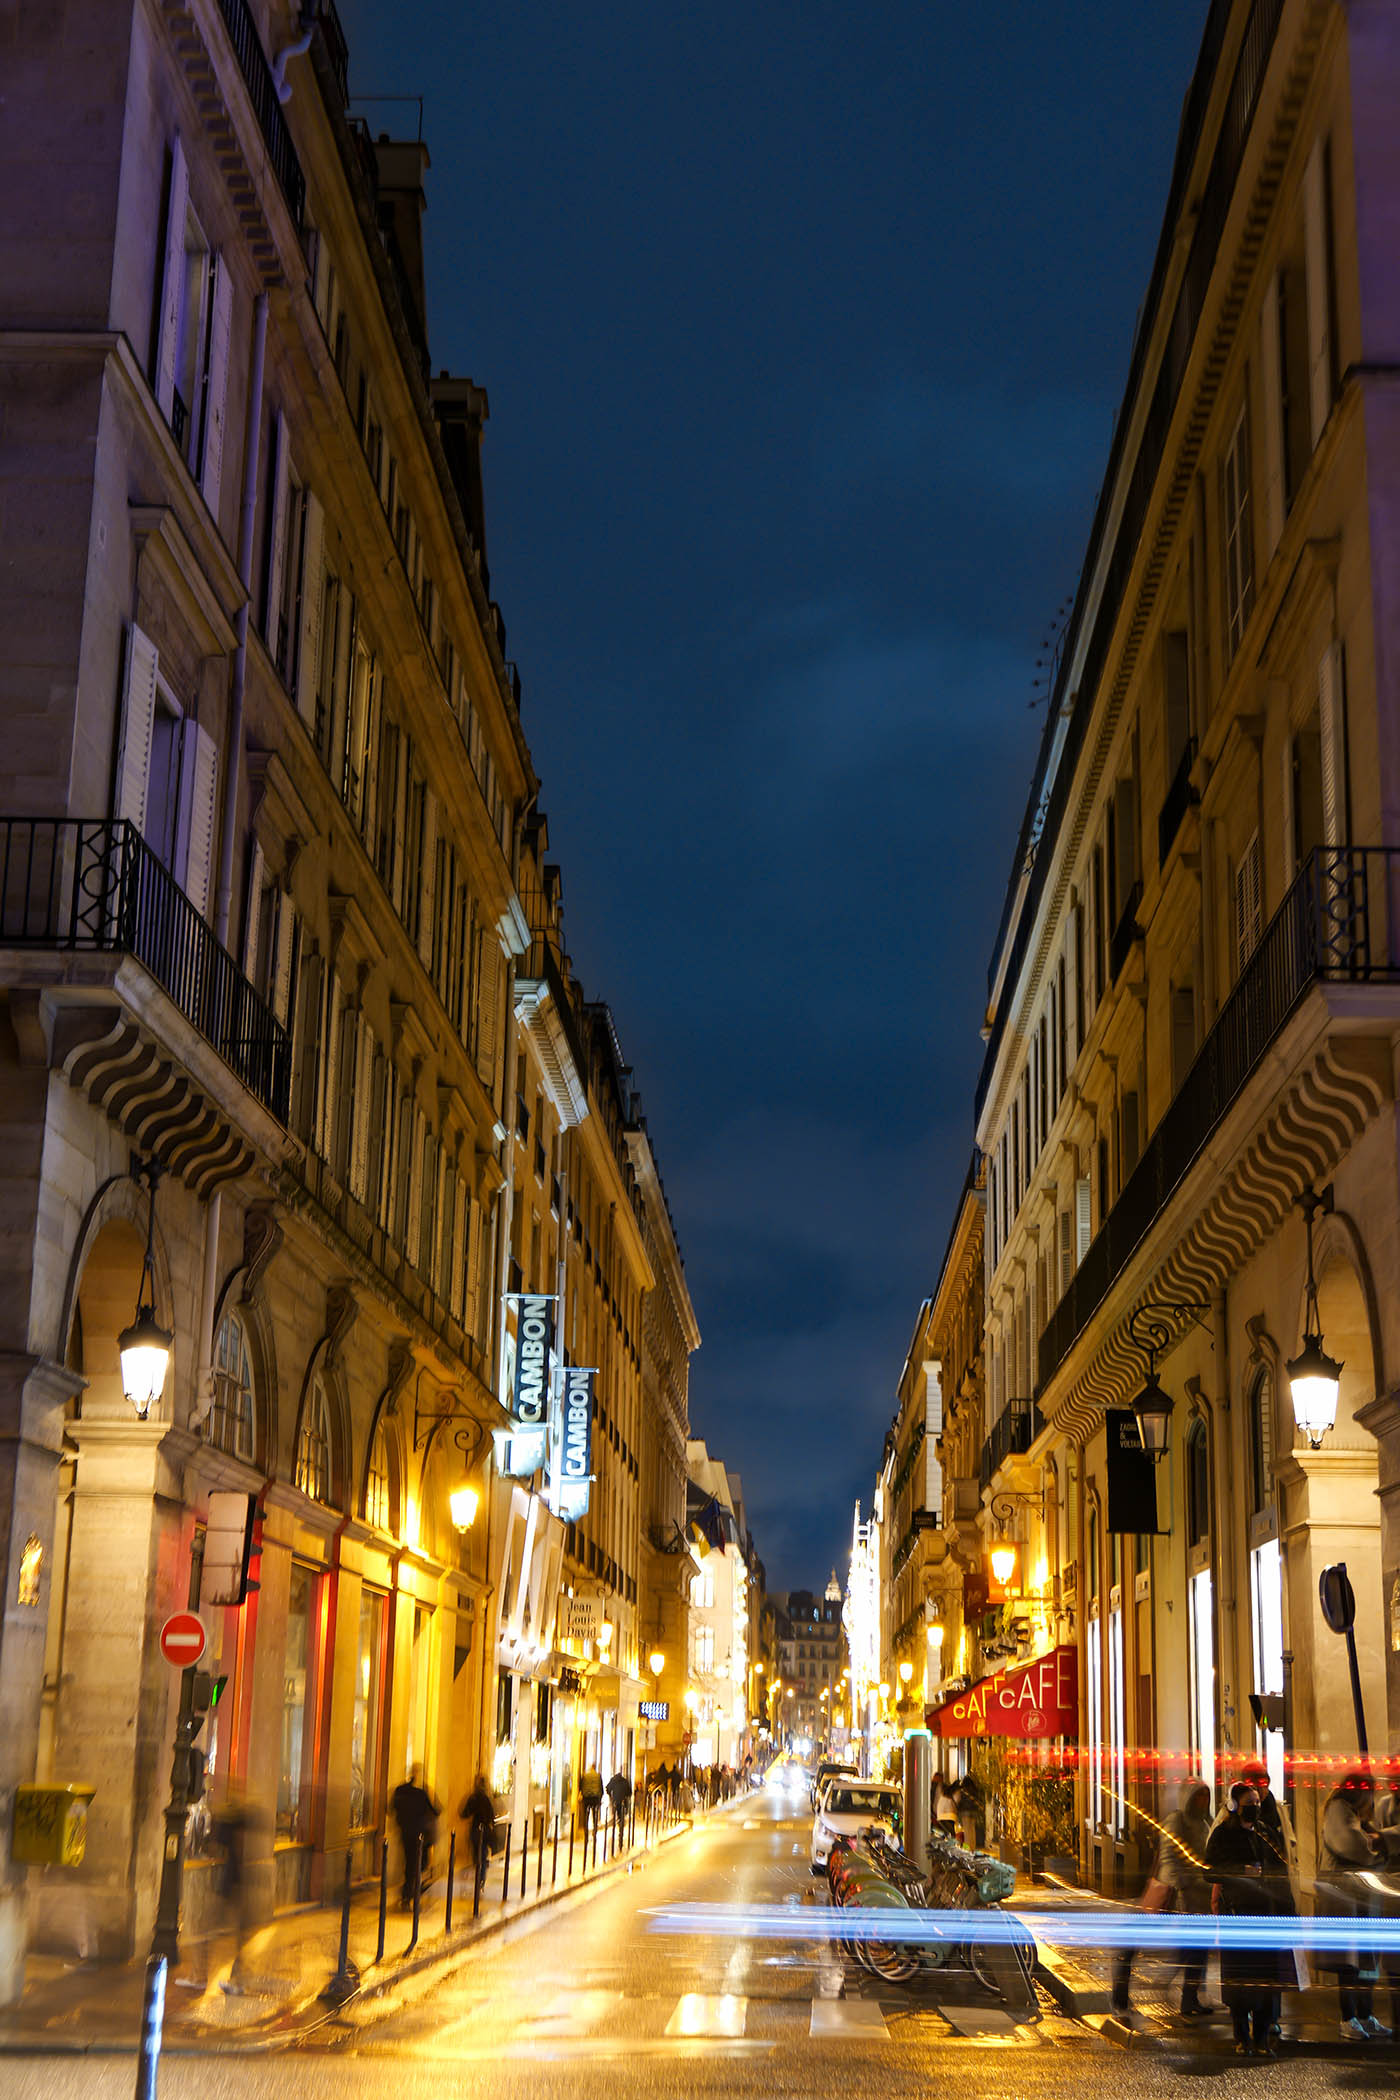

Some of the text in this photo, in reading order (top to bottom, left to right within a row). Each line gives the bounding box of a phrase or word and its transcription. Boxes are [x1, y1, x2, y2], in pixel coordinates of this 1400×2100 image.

[518, 1298, 547, 1423] CAMBON
[566, 1372, 590, 1476] CAMBON
[568, 1600, 592, 1613] Jean
[568, 1613, 597, 1625] Louis
[567, 1626, 597, 1639] David
